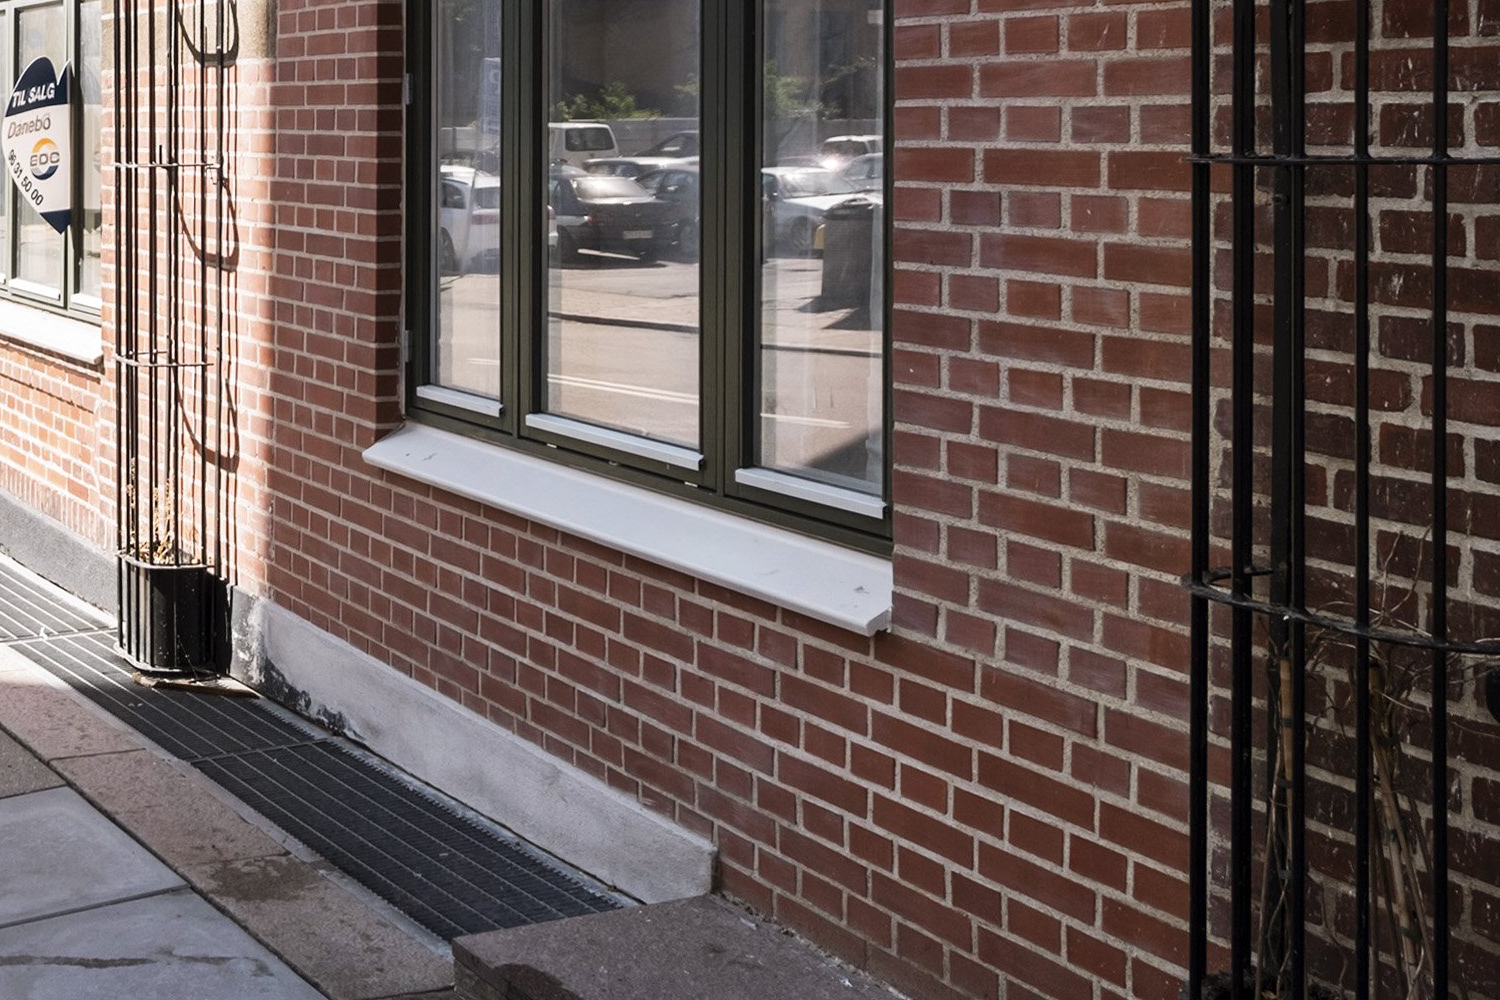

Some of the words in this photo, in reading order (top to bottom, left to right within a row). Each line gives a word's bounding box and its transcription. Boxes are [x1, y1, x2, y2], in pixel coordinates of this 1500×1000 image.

[12, 89, 26, 108] TIL
[28, 82, 55, 104] SALG
[30, 151, 60, 167] EDC
[13, 162, 23, 179] 31
[21, 175, 32, 193] 50
[30, 188, 44, 205] 00
